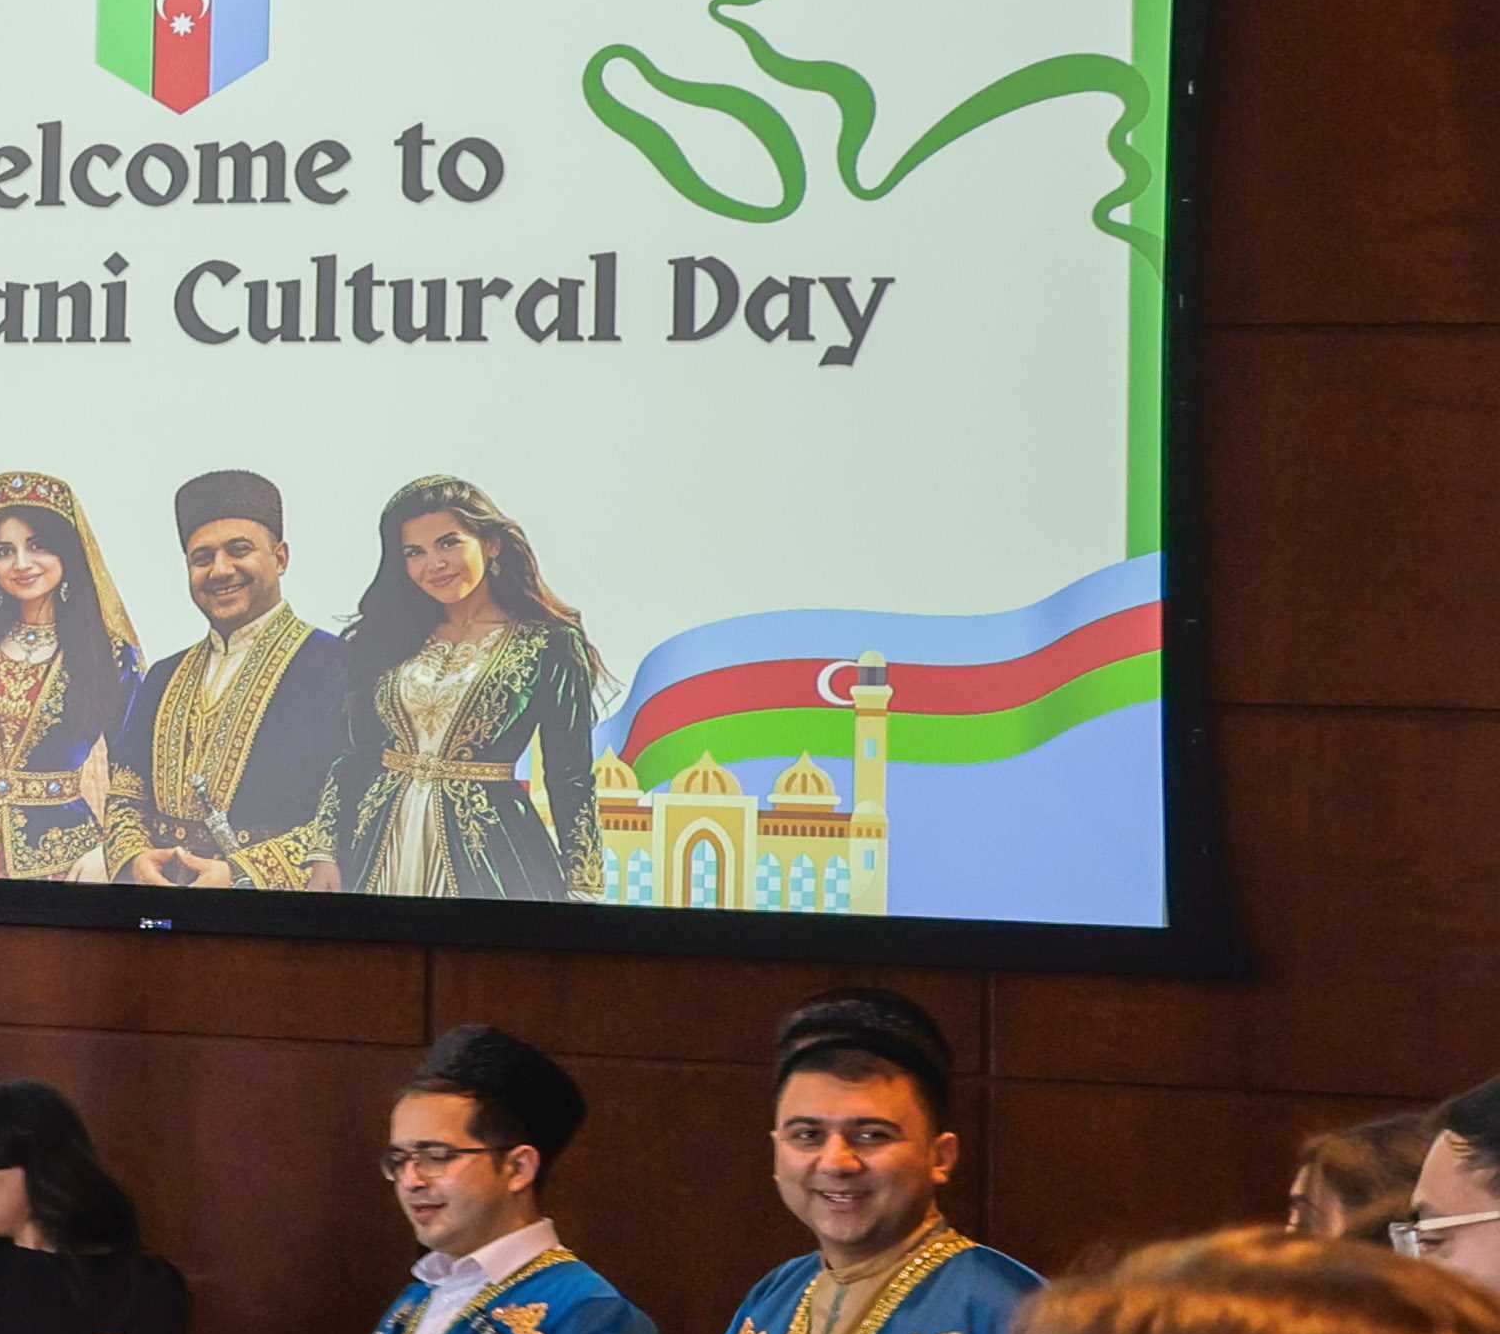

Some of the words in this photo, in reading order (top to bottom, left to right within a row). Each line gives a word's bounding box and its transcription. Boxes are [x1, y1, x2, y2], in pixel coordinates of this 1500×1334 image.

[393, 119, 503, 204] to
[173, 251, 619, 345] Cultural
[666, 255, 895, 367] Day
